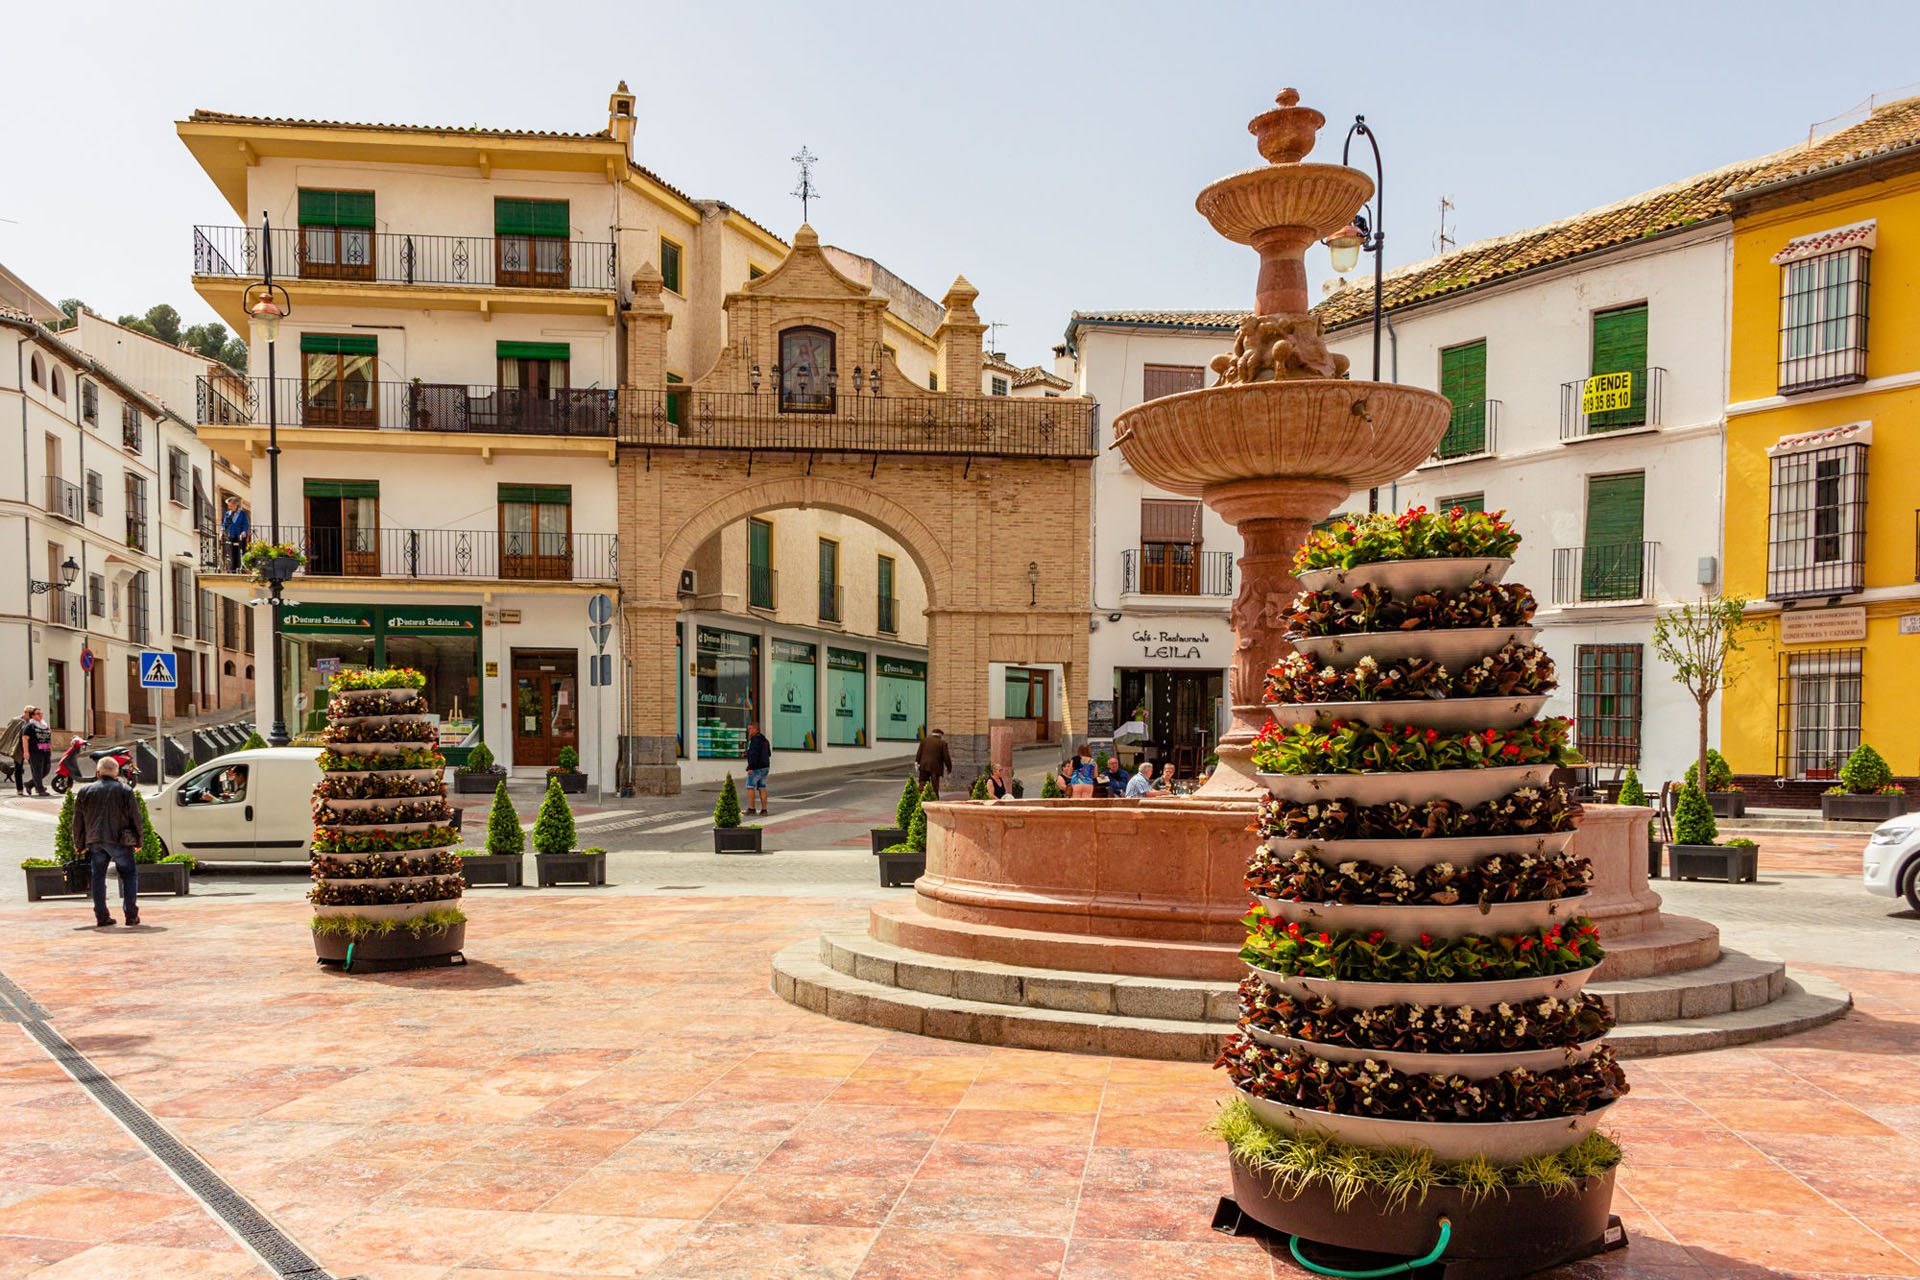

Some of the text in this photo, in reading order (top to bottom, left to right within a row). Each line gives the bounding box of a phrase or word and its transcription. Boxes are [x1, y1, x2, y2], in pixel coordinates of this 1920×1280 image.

[1585, 374, 1629, 395] SE VENDE
[1583, 391, 1629, 412] 619 35 85 10
[1132, 630, 1151, 642] Café
[1159, 631, 1209, 642] Restaurante
[1144, 645, 1201, 659] LEILA
